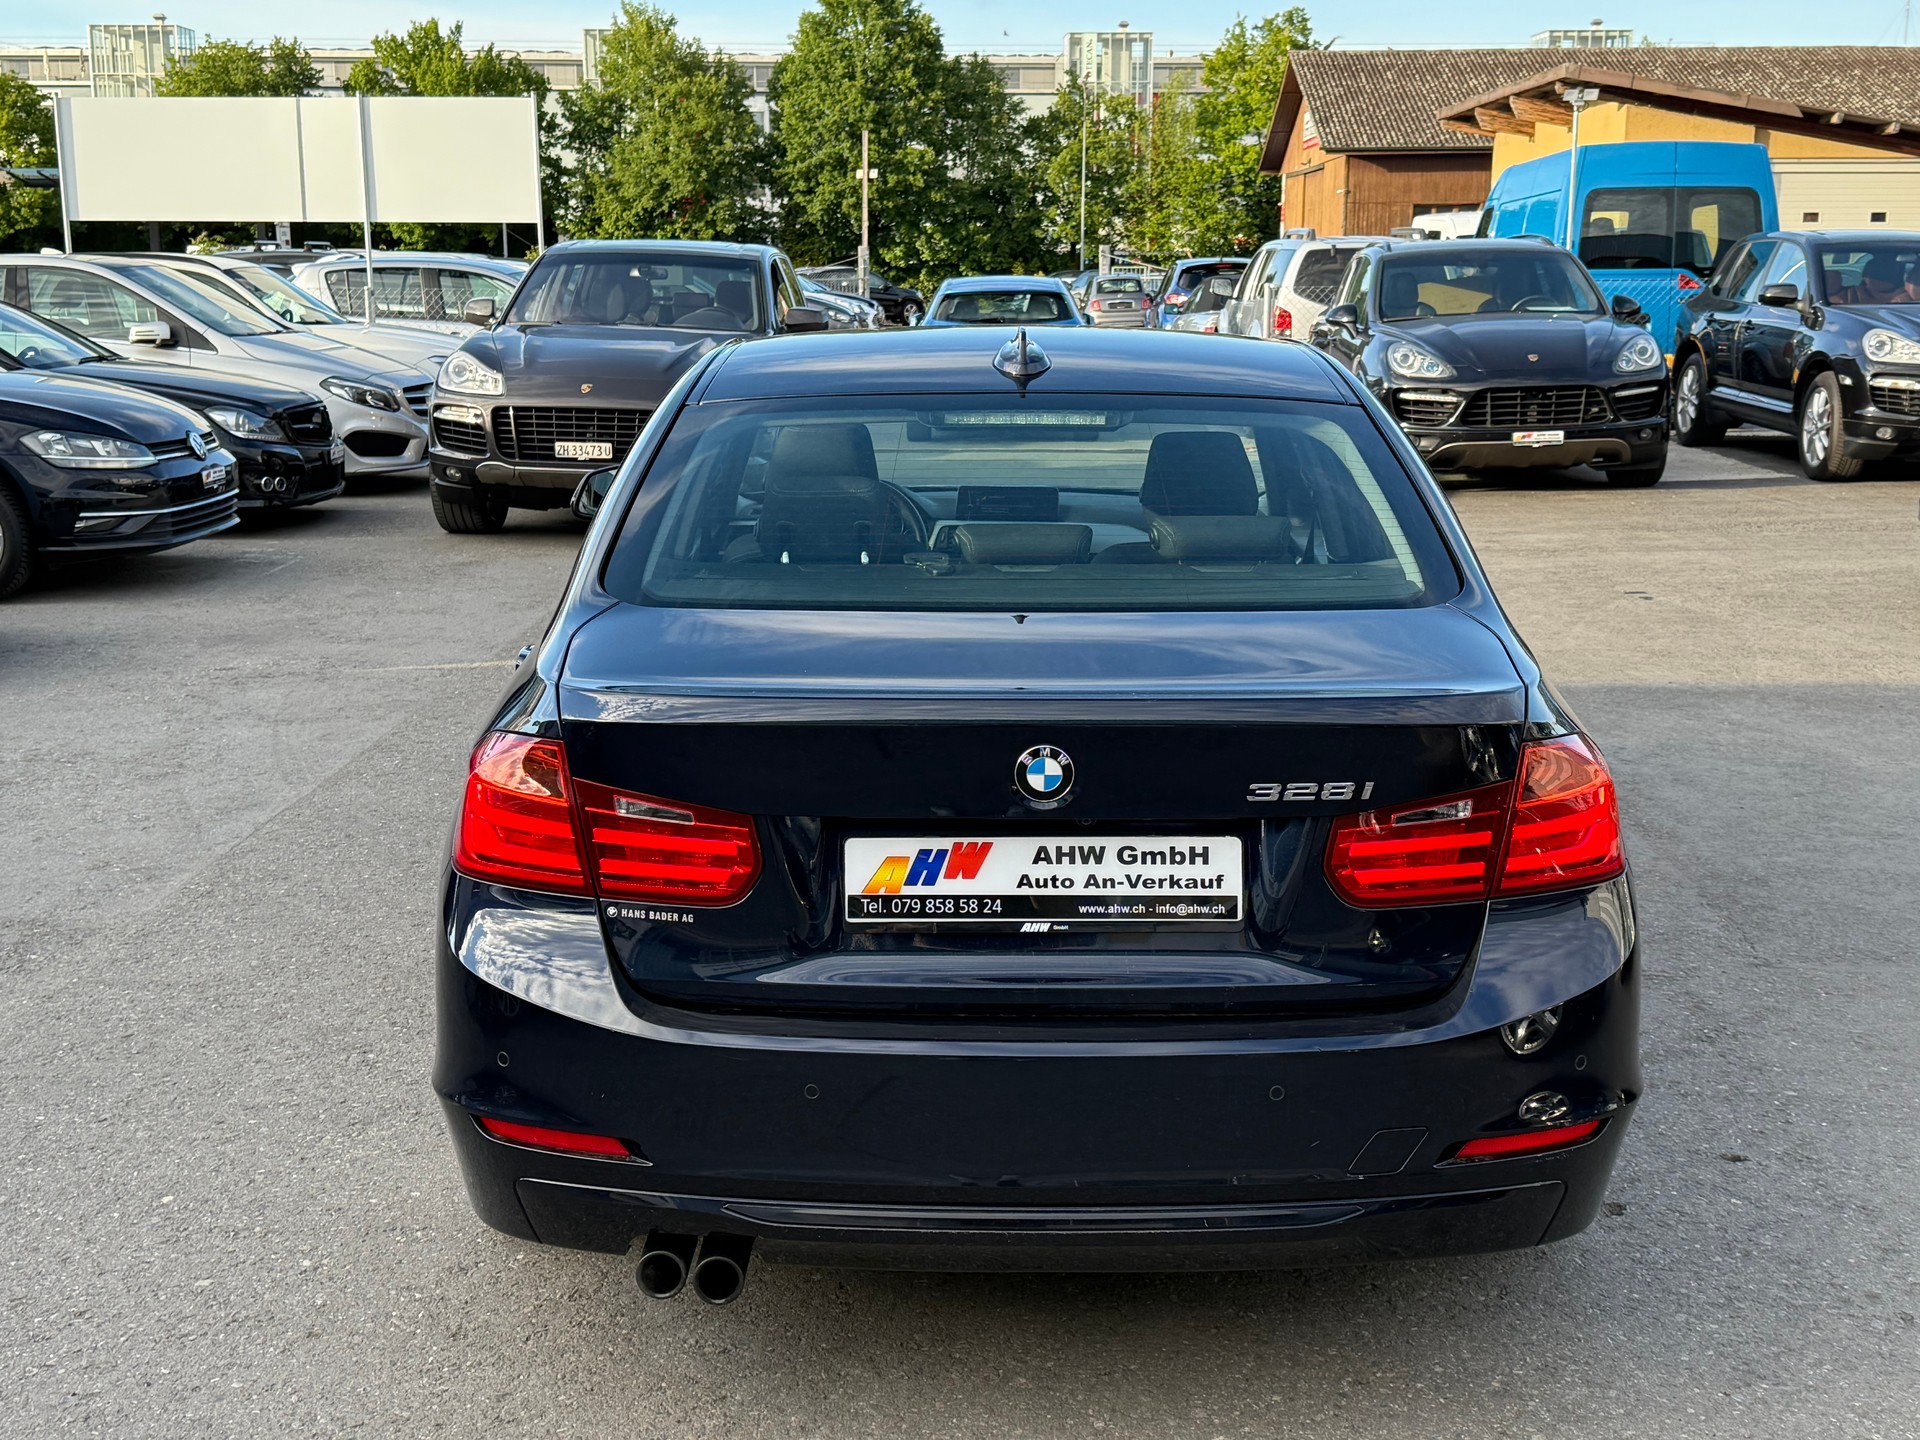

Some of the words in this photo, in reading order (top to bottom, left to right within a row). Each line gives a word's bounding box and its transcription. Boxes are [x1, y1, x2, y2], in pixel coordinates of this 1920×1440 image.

[557, 445, 569, 456] ZH
[1021, 747, 1070, 766] BMW
[1246, 782, 1375, 801] 328i
[1032, 846, 1106, 865] AHW
[1116, 846, 1210, 866] GmbH
[861, 842, 994, 894] AHW
[1016, 874, 1075, 889] Auto
[1083, 874, 1225, 890] An-Verkauf
[860, 898, 887, 914] Tel.
[891, 898, 921, 914] 079
[925, 898, 954, 914] 858
[958, 898, 978, 914] 58
[982, 898, 1002, 914] 24
[1078, 904, 1146, 914] www.ahw.ch
[1155, 903, 1226, 916] info@ahw.ch
[621, 908, 646, 919] HANS
[649, 911, 678, 922] BADER
[681, 914, 694, 923] AG
[1020, 922, 1052, 932] AHW
